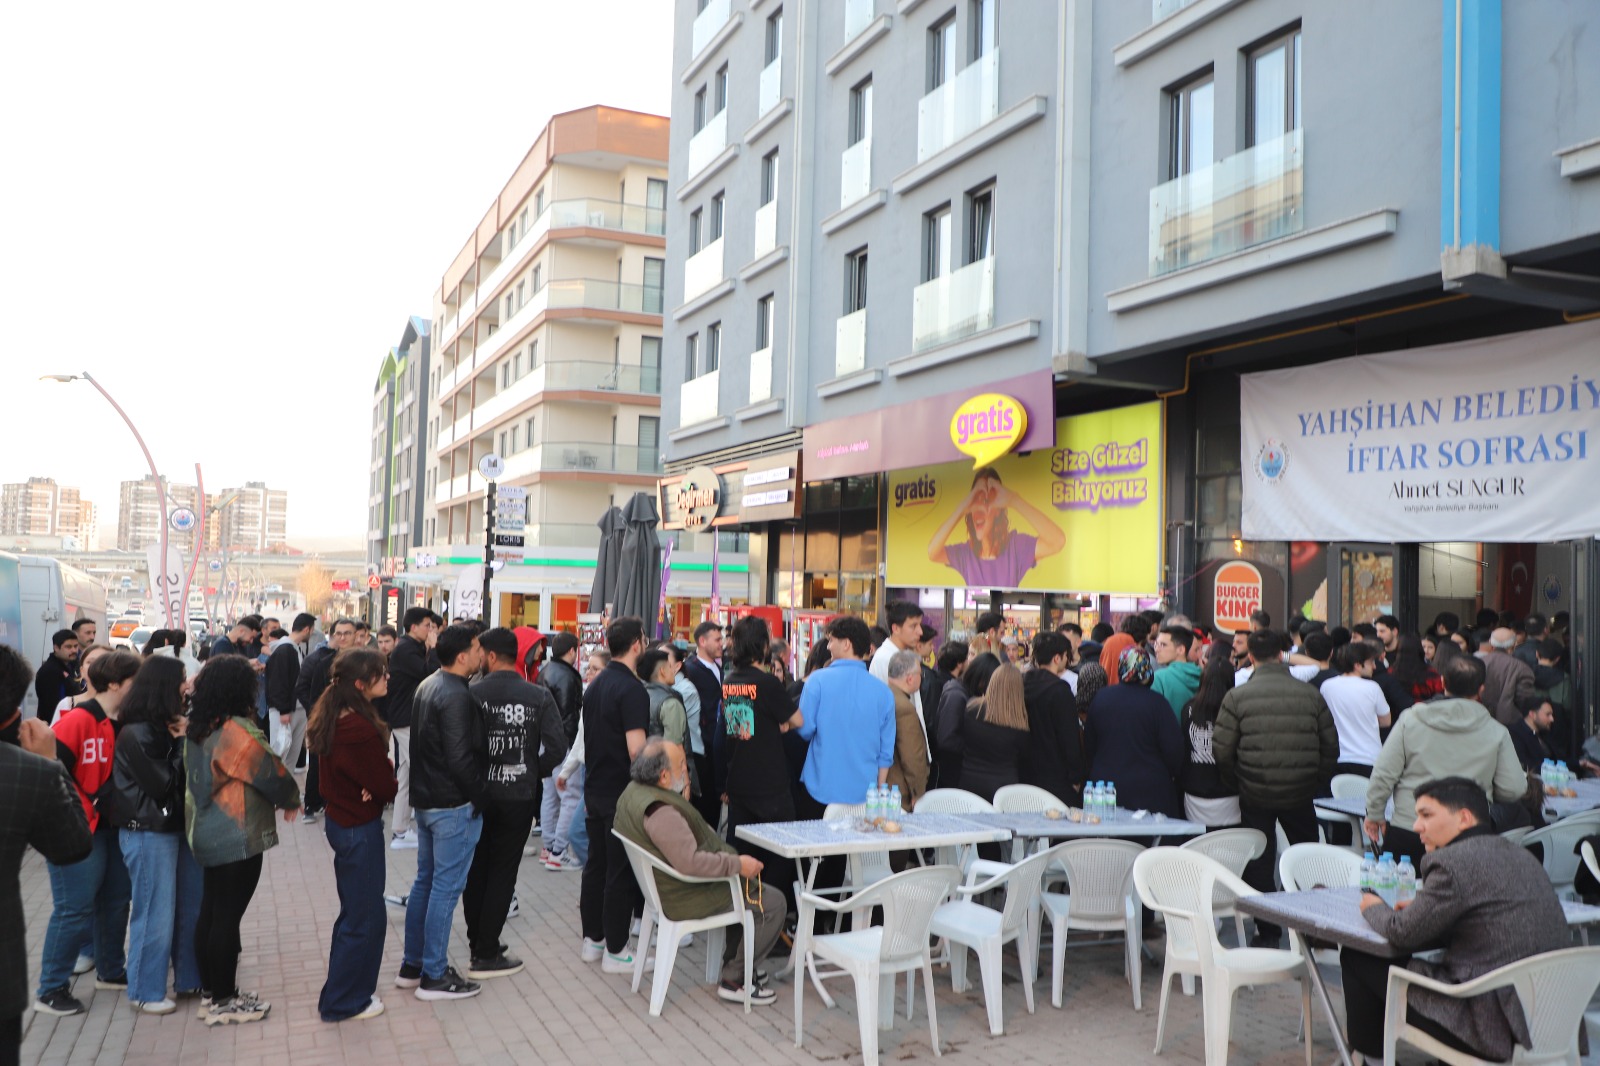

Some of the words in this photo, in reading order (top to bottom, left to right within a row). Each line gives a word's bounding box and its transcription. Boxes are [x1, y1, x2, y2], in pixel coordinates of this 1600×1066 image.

[956, 399, 1014, 444] gratis
[1297, 399, 1443, 438] YAHŞİHAN
[1452, 373, 1600, 423] BELEDİY
[1051, 447, 1091, 479] Size
[1092, 437, 1148, 476] Güzel
[1347, 442, 1429, 474] İFTAR
[1437, 429, 1589, 469] SOFRASI
[894, 472, 937, 508] gratis
[1051, 477, 1148, 513] Bakıyoruz
[1389, 480, 1442, 500] Ahmet
[1446, 476, 1525, 497] SUNGUR
[1216, 585, 1260, 599] BURGER
[1216, 600, 1259, 618] KING
